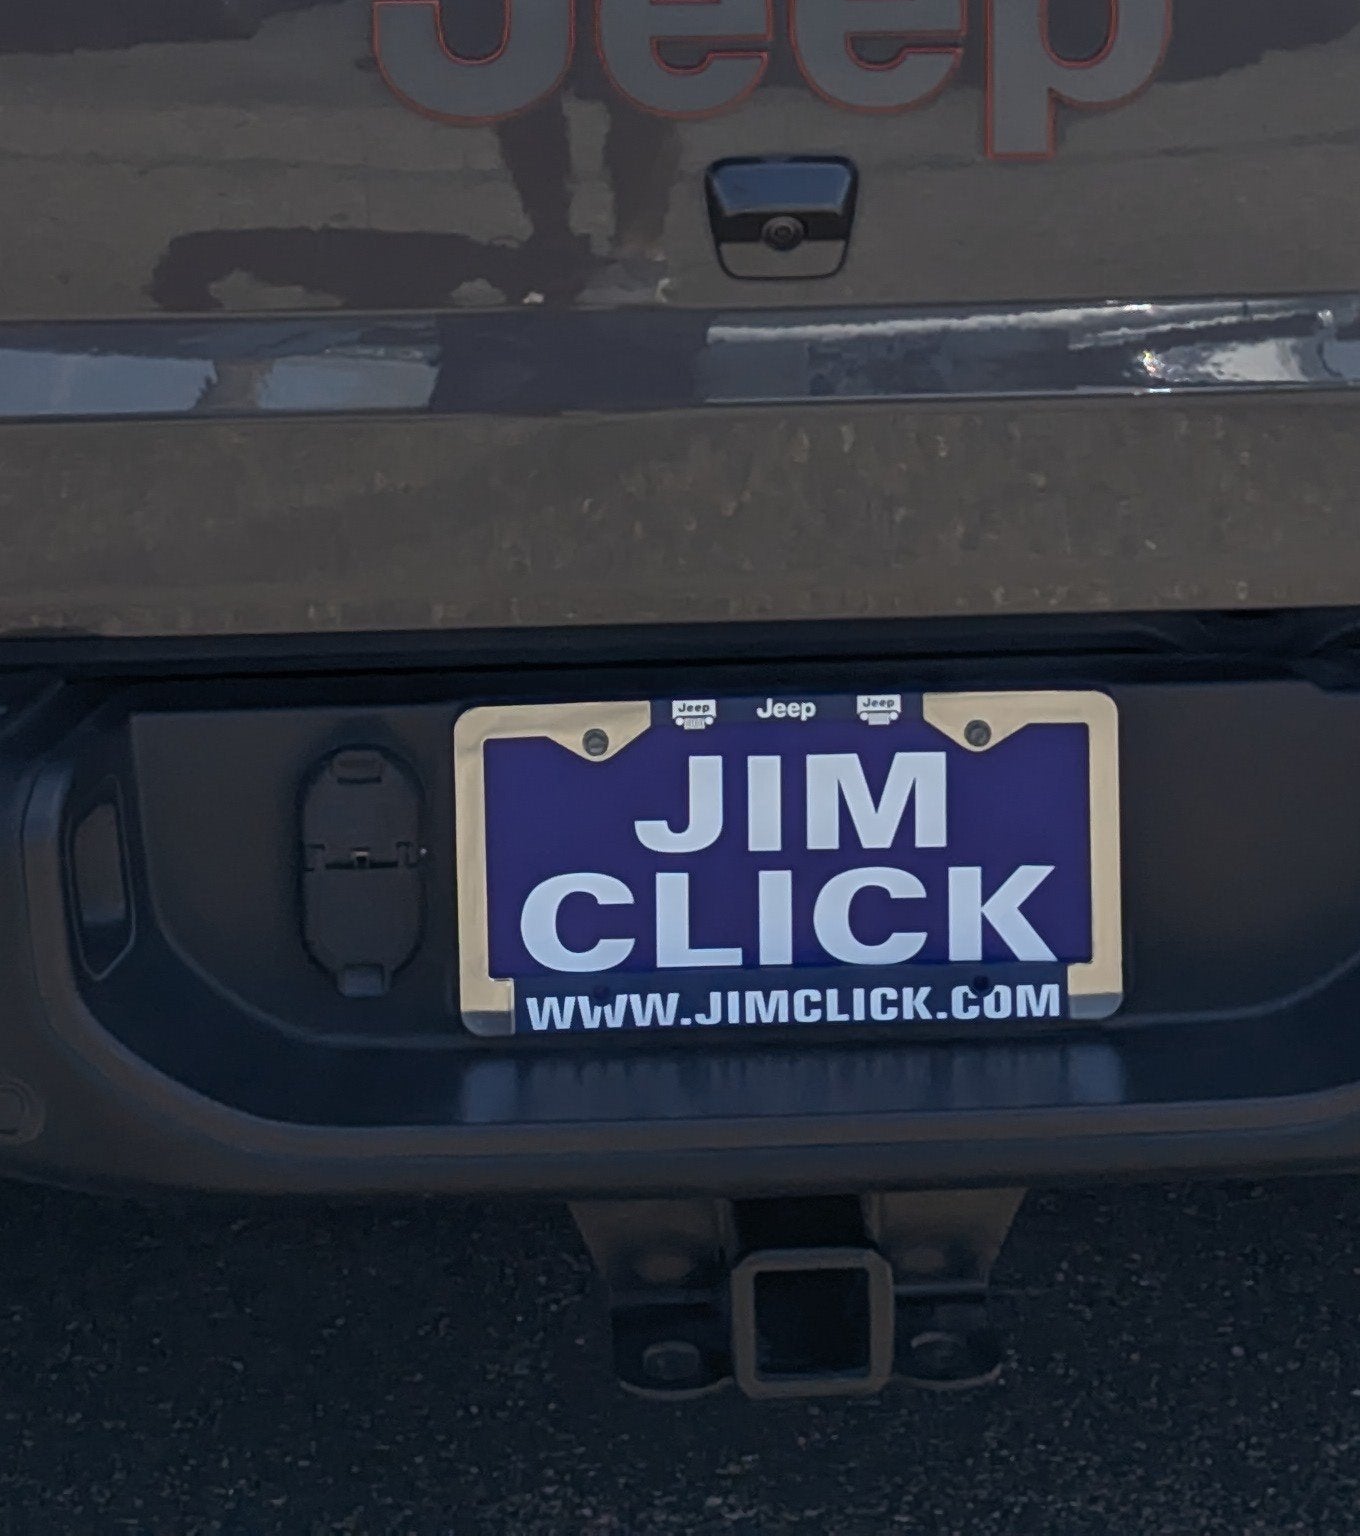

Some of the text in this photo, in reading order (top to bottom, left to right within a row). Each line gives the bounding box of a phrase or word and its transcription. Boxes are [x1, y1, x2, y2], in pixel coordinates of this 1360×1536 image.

[678, 697, 895, 722] Jeep Jeep Jeep
[634, 751, 948, 853] JIM
[520, 865, 1057, 972] CLICK
[526, 983, 1061, 1031] WWW.JIMCLICK.COM
